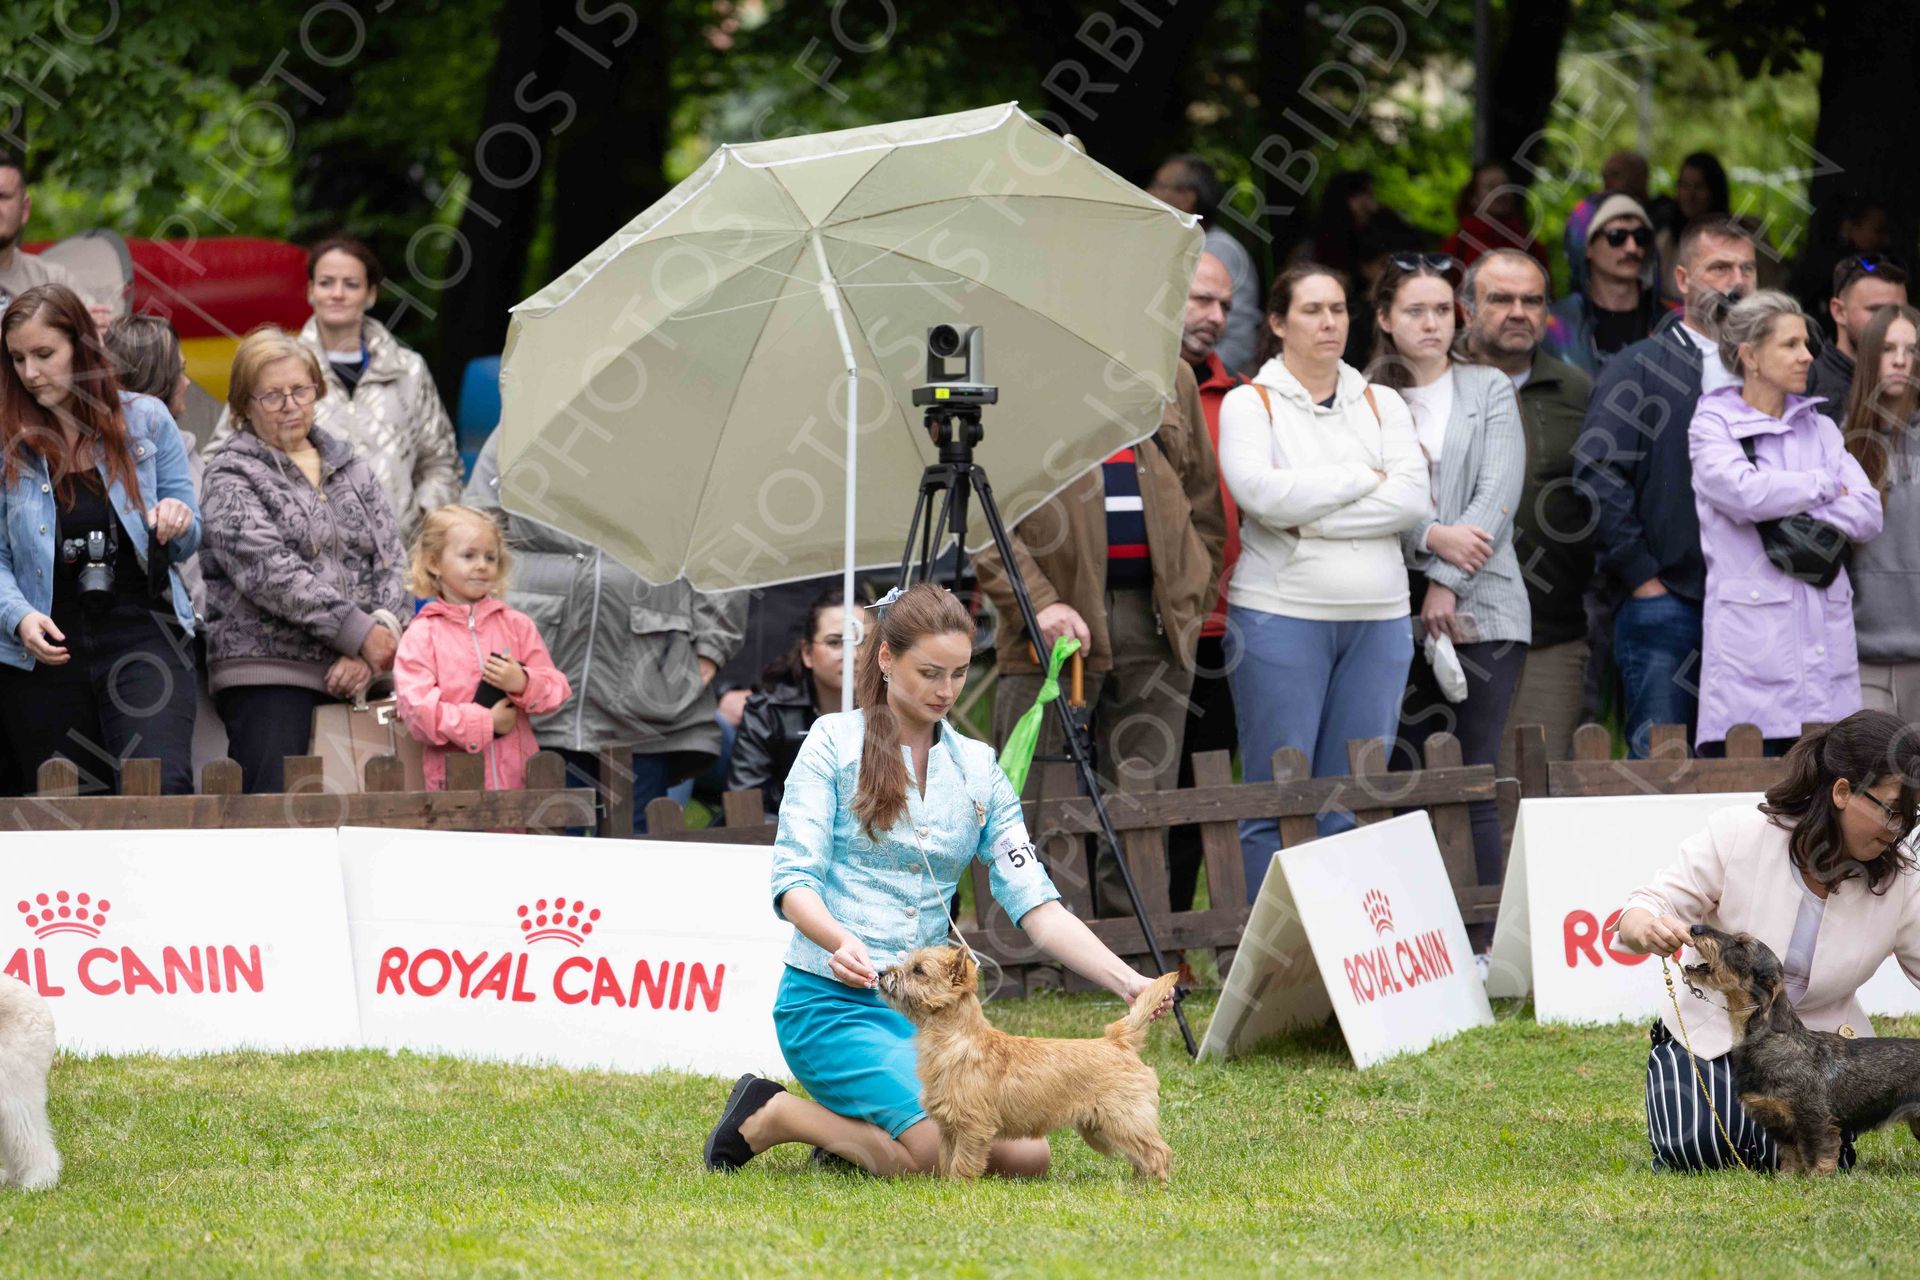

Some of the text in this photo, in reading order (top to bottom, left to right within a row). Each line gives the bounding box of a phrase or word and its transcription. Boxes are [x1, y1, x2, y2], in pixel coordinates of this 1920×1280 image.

[78, 944, 264, 996] CANIN
[376, 946, 726, 1013] ROYAL CANIN
[1343, 928, 1454, 1006] ROYAL CANIN
